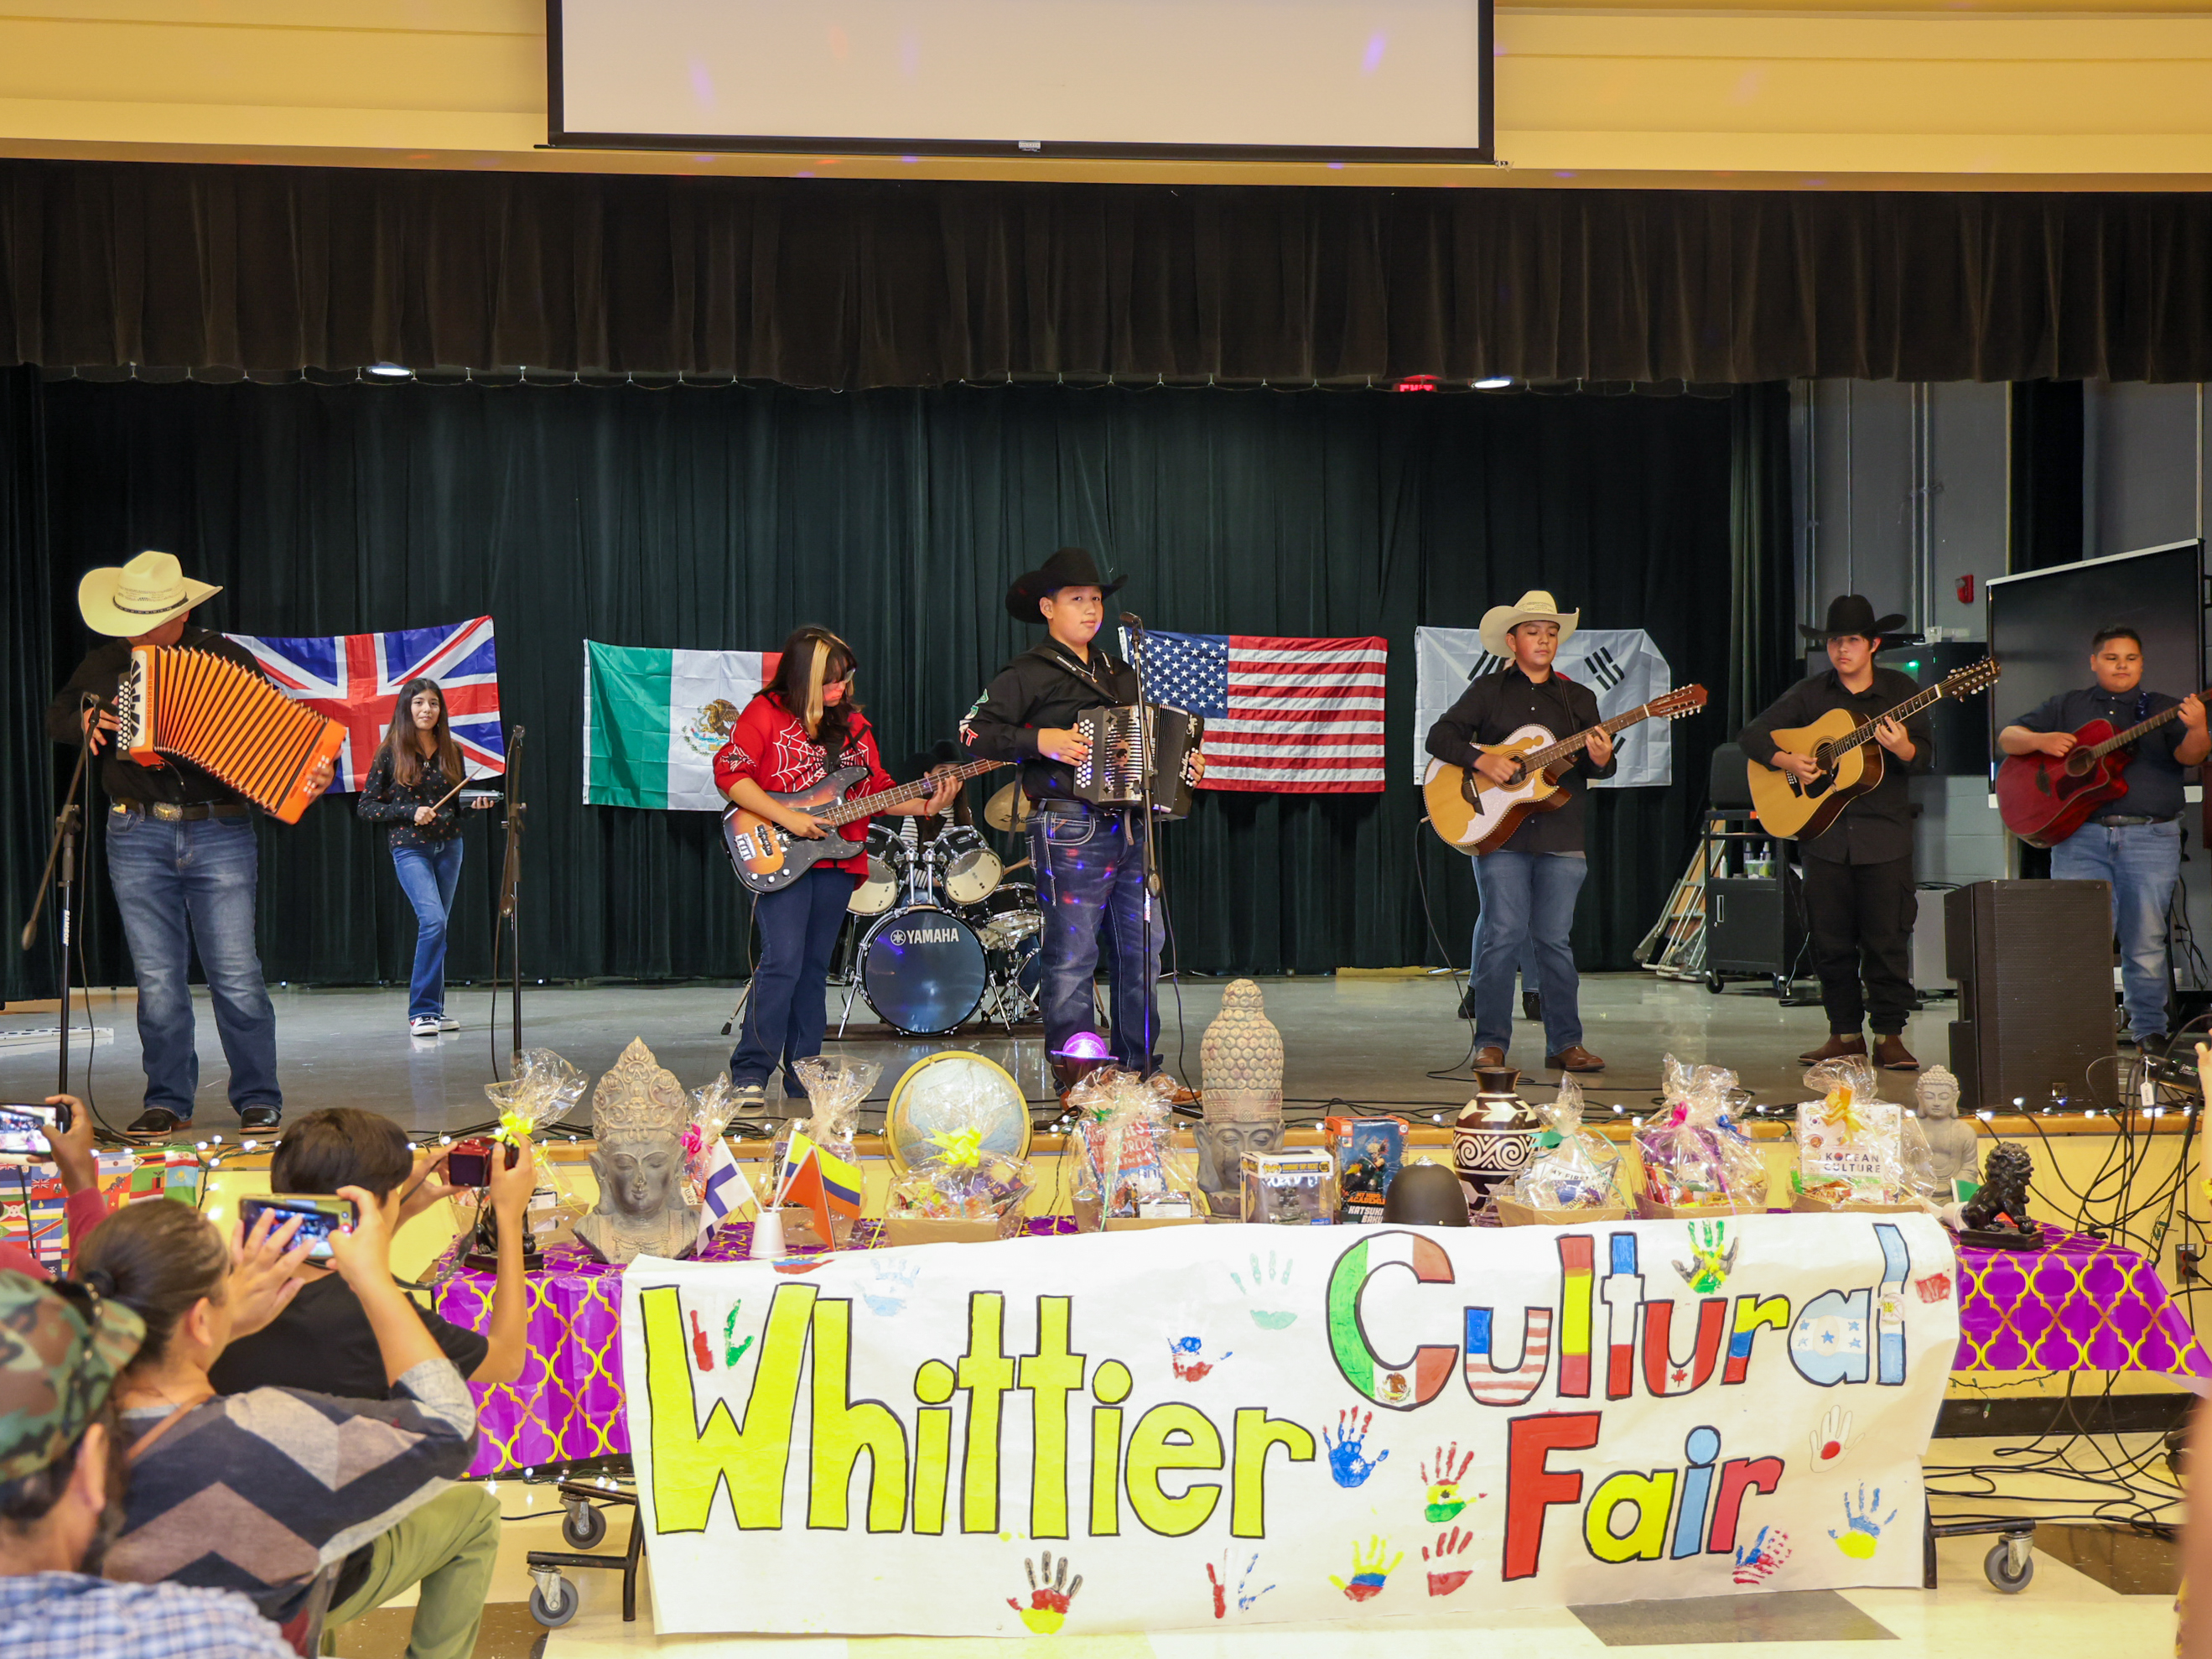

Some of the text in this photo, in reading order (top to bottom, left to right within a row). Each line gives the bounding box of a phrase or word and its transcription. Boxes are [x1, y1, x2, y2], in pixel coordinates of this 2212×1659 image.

[1179, 751, 1190, 780] Panther
[906, 928, 959, 944] YAMAHA
[1824, 1163, 1881, 1173] CULTURE
[1825, 1152, 1878, 1162] KOREAN
[1347, 1205, 1384, 1216] KATSUKI
[1325, 1222, 1910, 1412] Cultural
[640, 1282, 1316, 1541] Whittier
[1502, 1410, 1785, 1582] Fair
